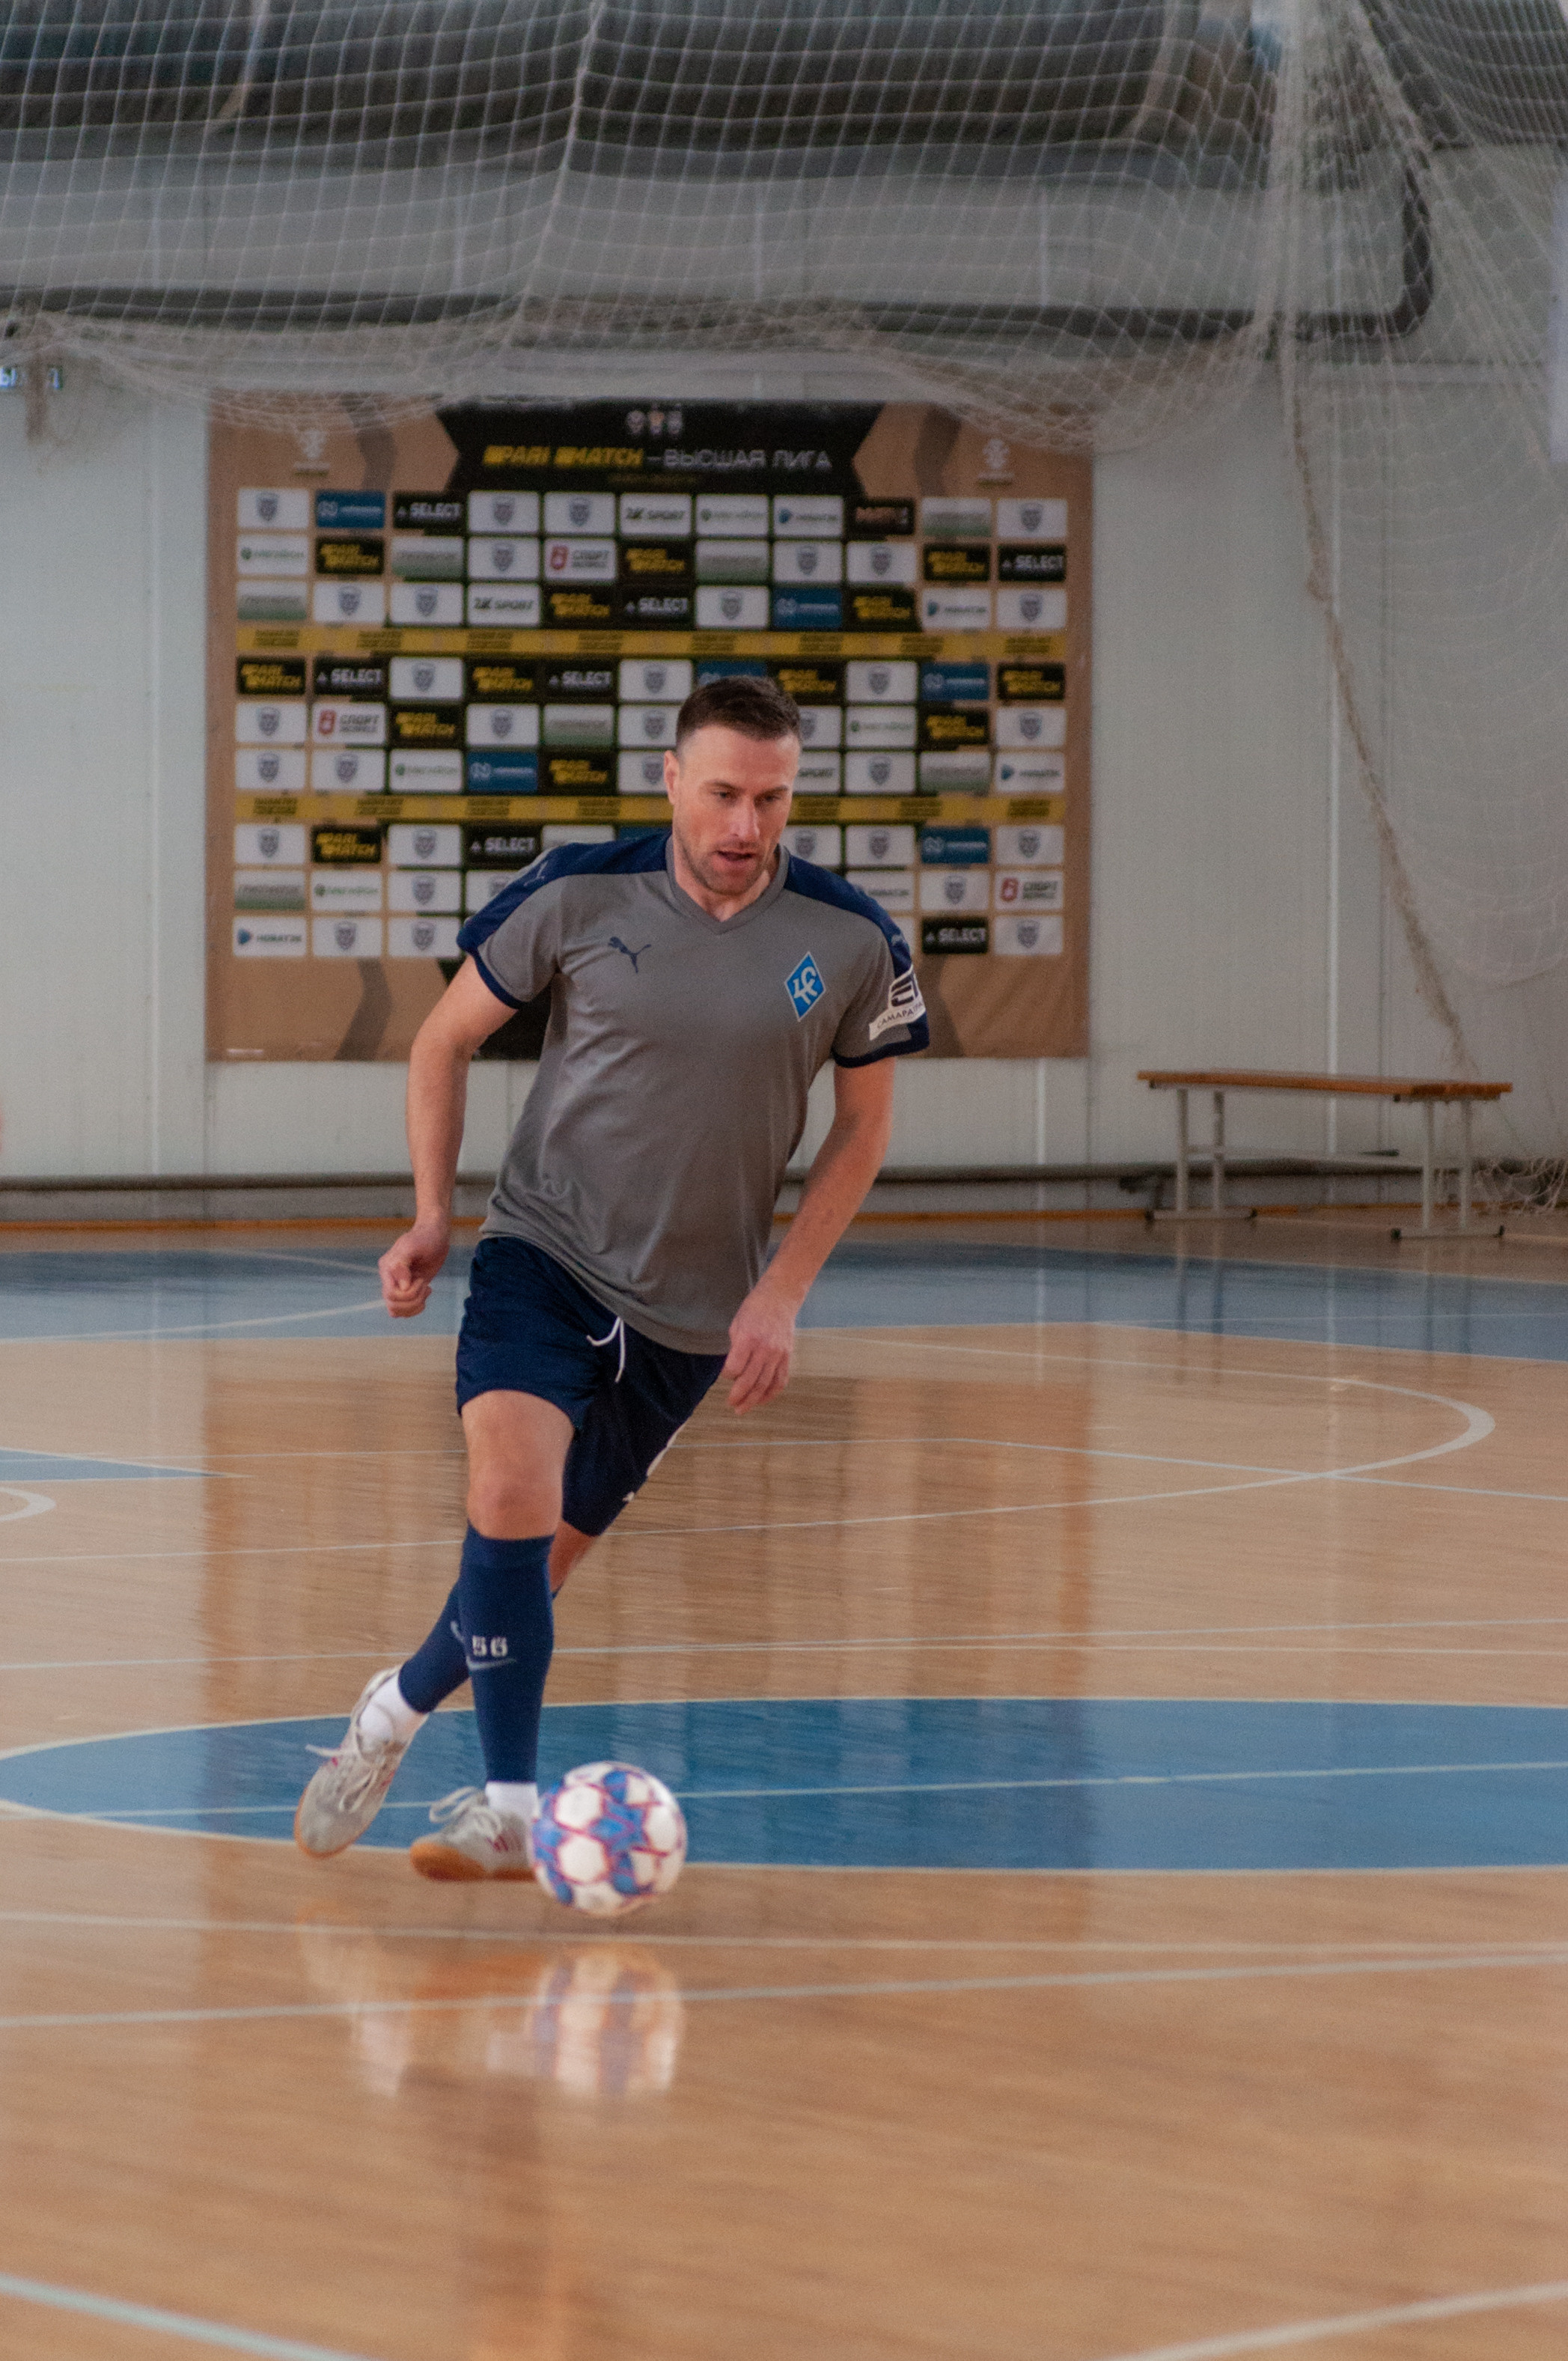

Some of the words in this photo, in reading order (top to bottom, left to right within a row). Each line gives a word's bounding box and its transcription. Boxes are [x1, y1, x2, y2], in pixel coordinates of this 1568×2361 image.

[663, 449, 766, 467] ВЫСШАЯ
[773, 450, 832, 468] ЛИГА
[409, 502, 462, 518] SELECT
[1015, 554, 1064, 569] SELECT
[330, 668, 382, 683] SELECT
[562, 671, 612, 686] SELECT
[484, 837, 535, 852] SELECT
[938, 927, 986, 942] SELECT
[472, 1635, 508, 1657] 56
